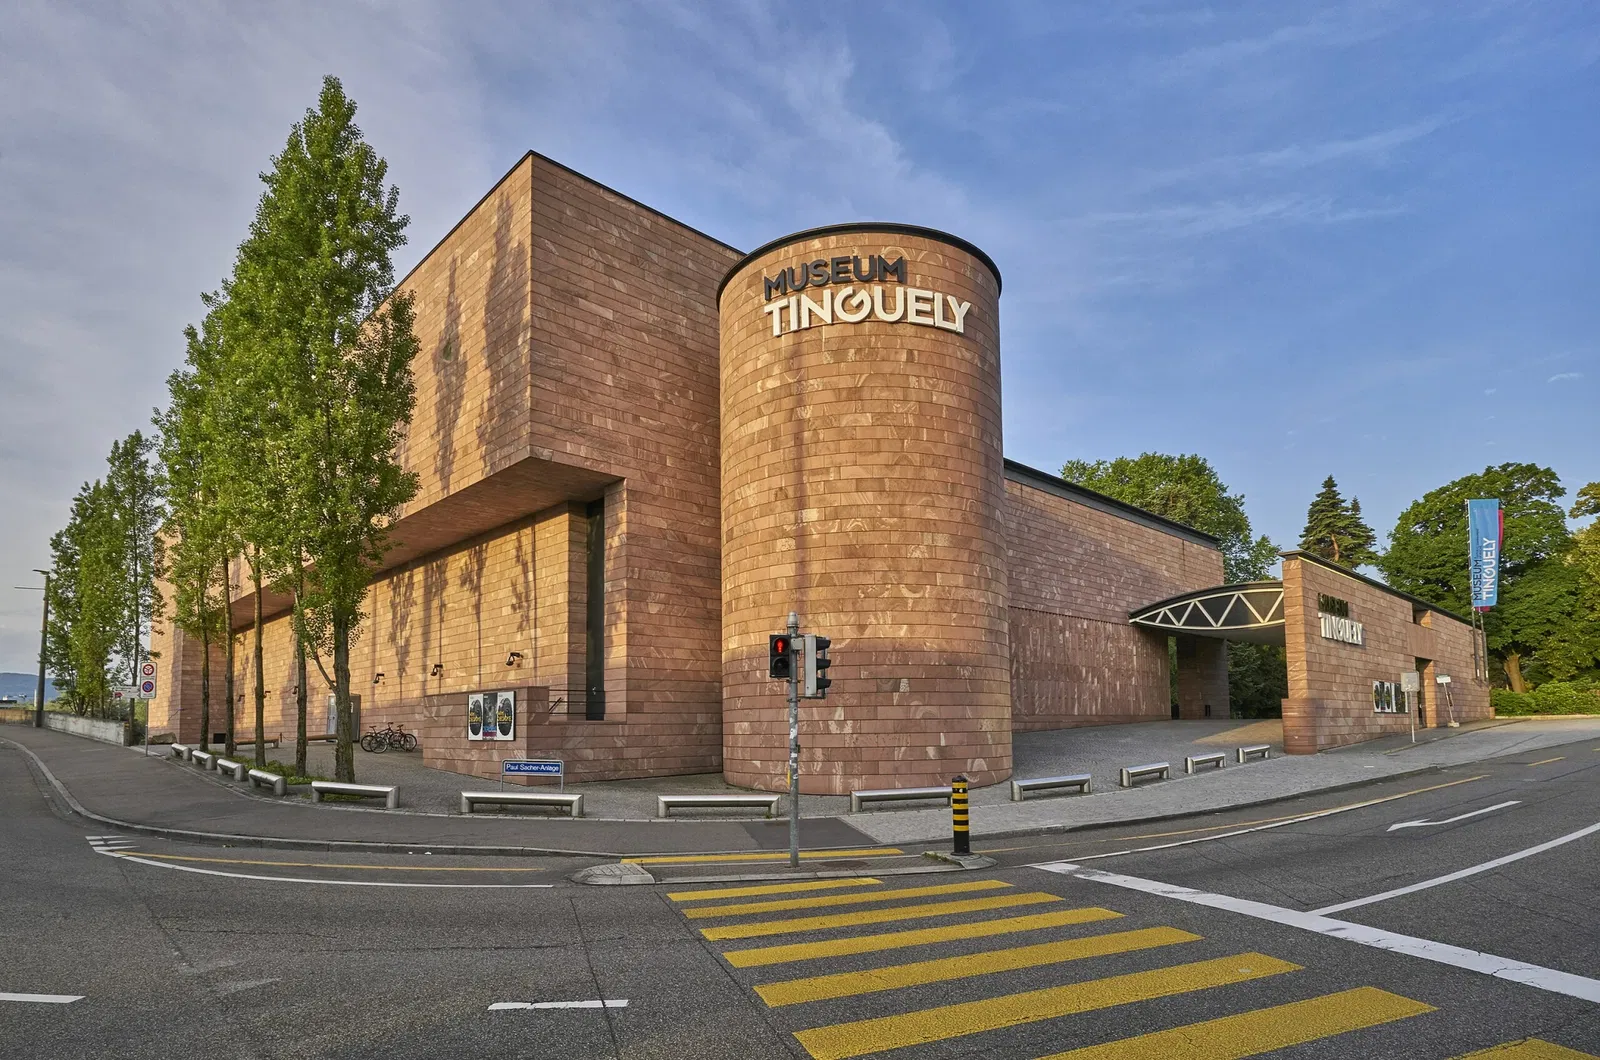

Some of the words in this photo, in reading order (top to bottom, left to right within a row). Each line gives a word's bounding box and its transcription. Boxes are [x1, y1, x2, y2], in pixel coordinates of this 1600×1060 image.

[764, 254, 907, 301] MUSEUM
[764, 286, 971, 337] TINGUELY
[1473, 560, 1482, 601] MUSEUM
[1482, 537, 1496, 601] TINGUELY
[1317, 612, 1363, 645] TINGUELY
[506, 763, 519, 771] Paul
[519, 763, 560, 772] Sacher-Anlage
